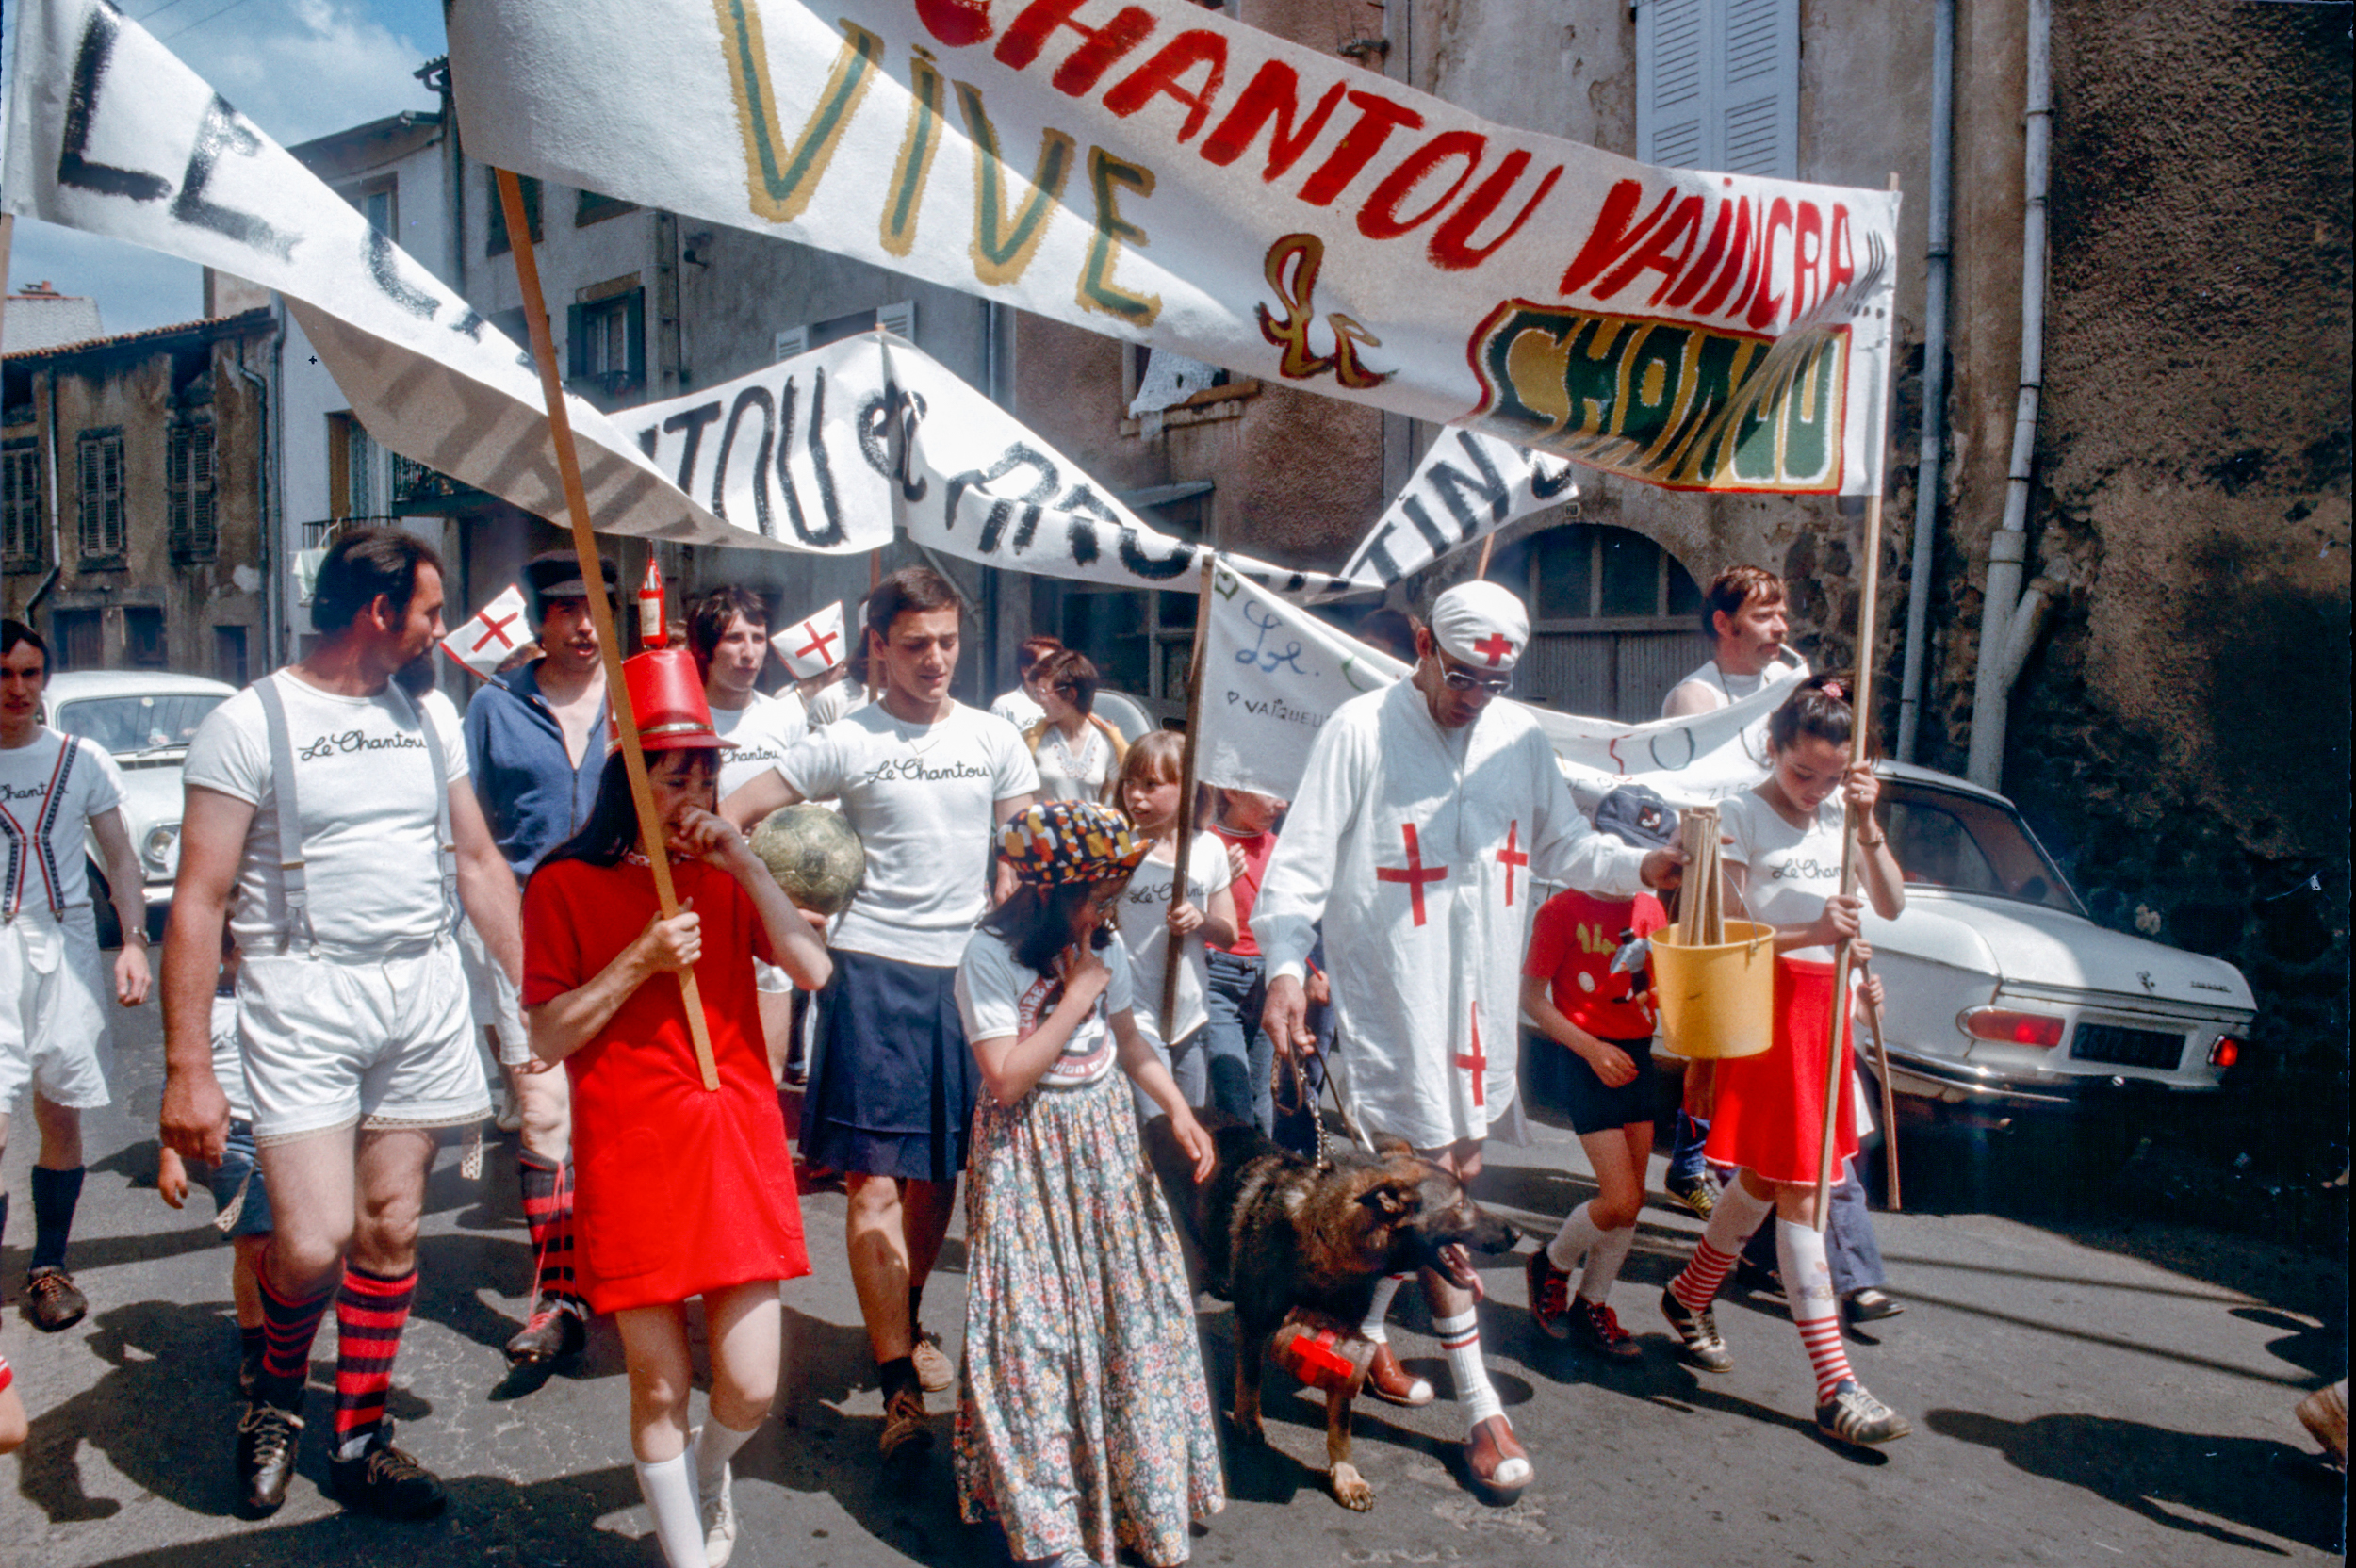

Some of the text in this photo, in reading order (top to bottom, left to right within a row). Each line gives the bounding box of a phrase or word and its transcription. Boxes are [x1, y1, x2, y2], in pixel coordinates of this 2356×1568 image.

[298, 729, 428, 761] Le Chantou
[865, 758, 990, 784] Le Chantou
[1769, 858, 1842, 880] Le Chan
[1129, 885, 1153, 904] Le
